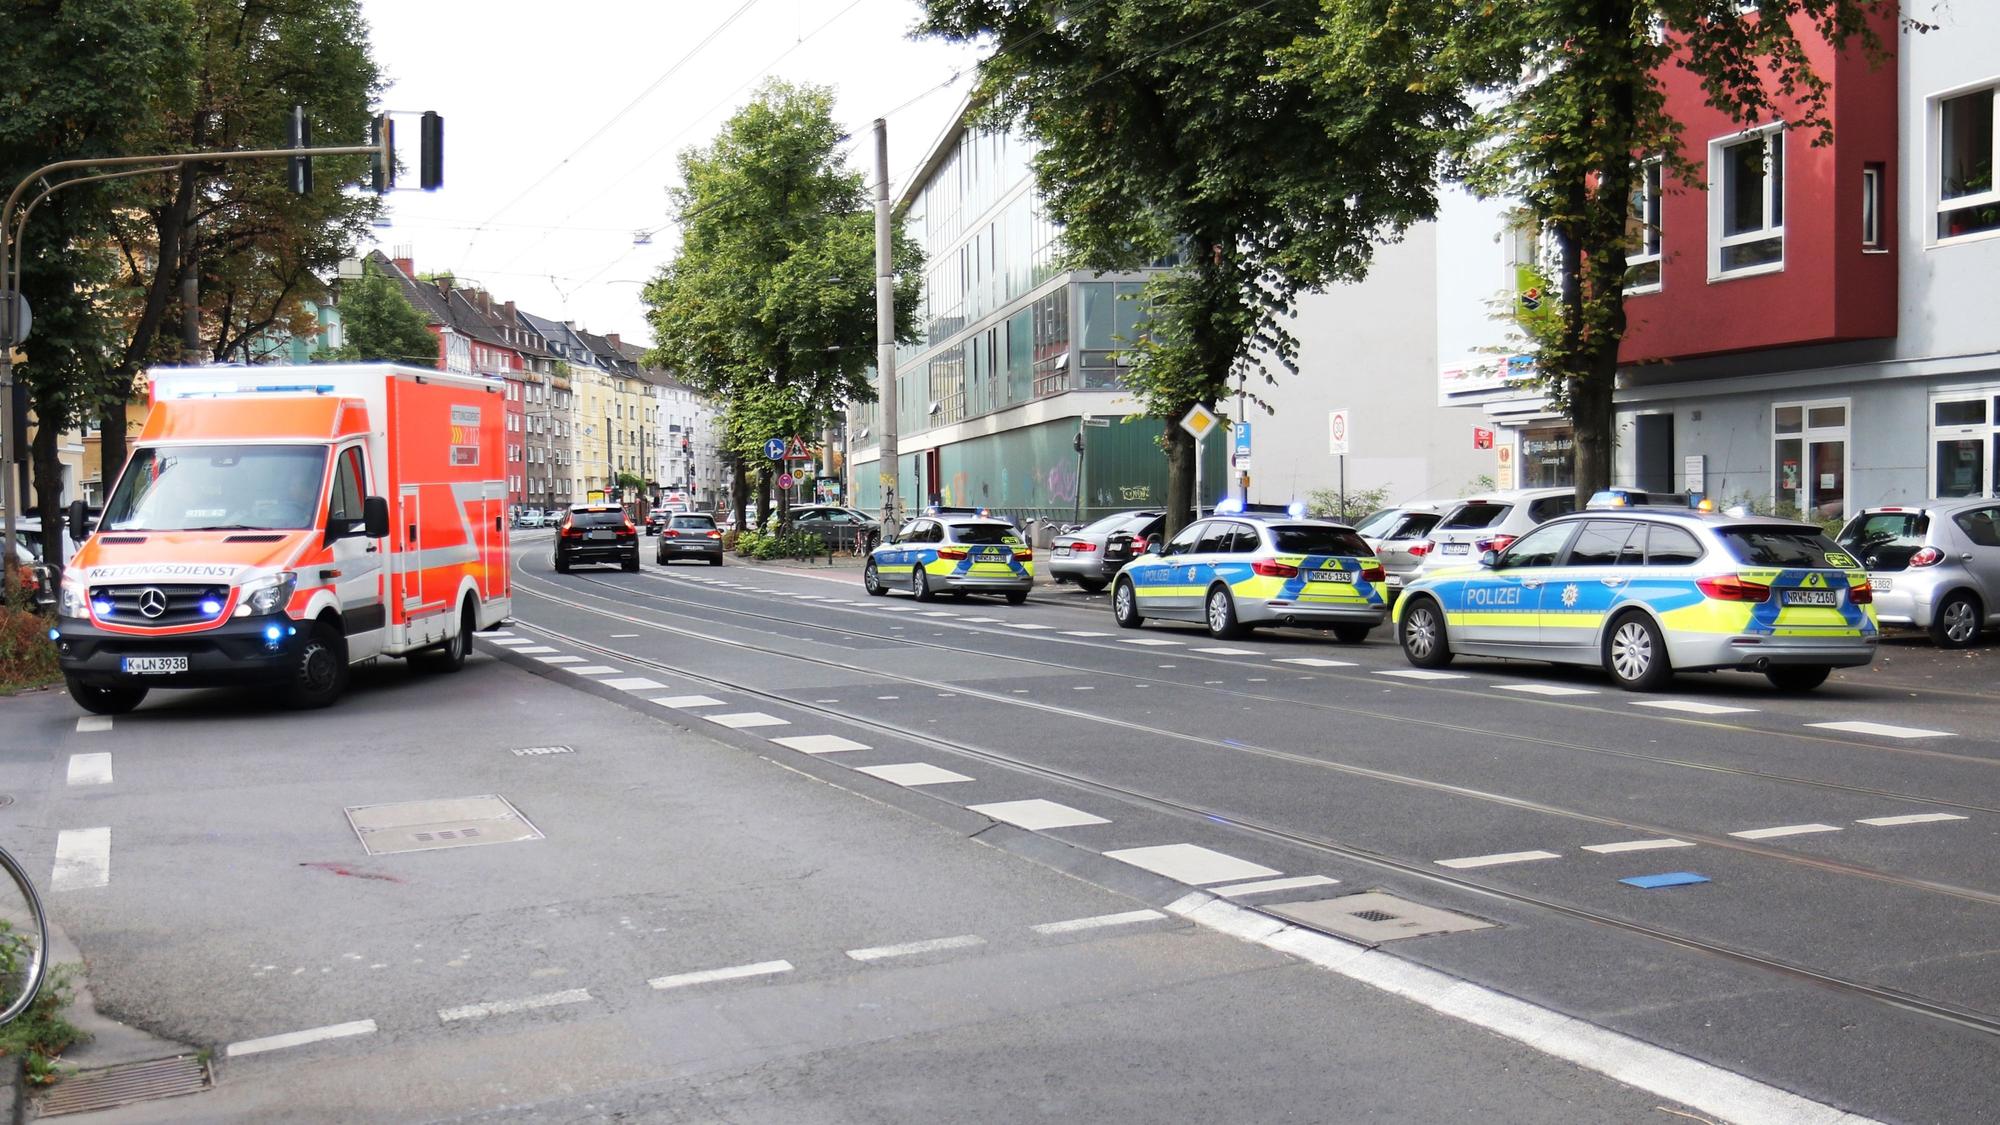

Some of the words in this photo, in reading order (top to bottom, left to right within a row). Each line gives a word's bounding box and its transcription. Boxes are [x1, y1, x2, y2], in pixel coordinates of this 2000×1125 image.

[90, 565, 239, 577] RETTUNGSDIENST
[1145, 568, 1168, 581] POLIZEI
[1467, 587, 1521, 605] POLIZEI
[1787, 591, 1803, 604] NRW
[1807, 591, 1836, 604] 6-2160
[128, 658, 135, 670] K
[141, 659, 156, 670] LN
[158, 658, 187, 670] 3938
